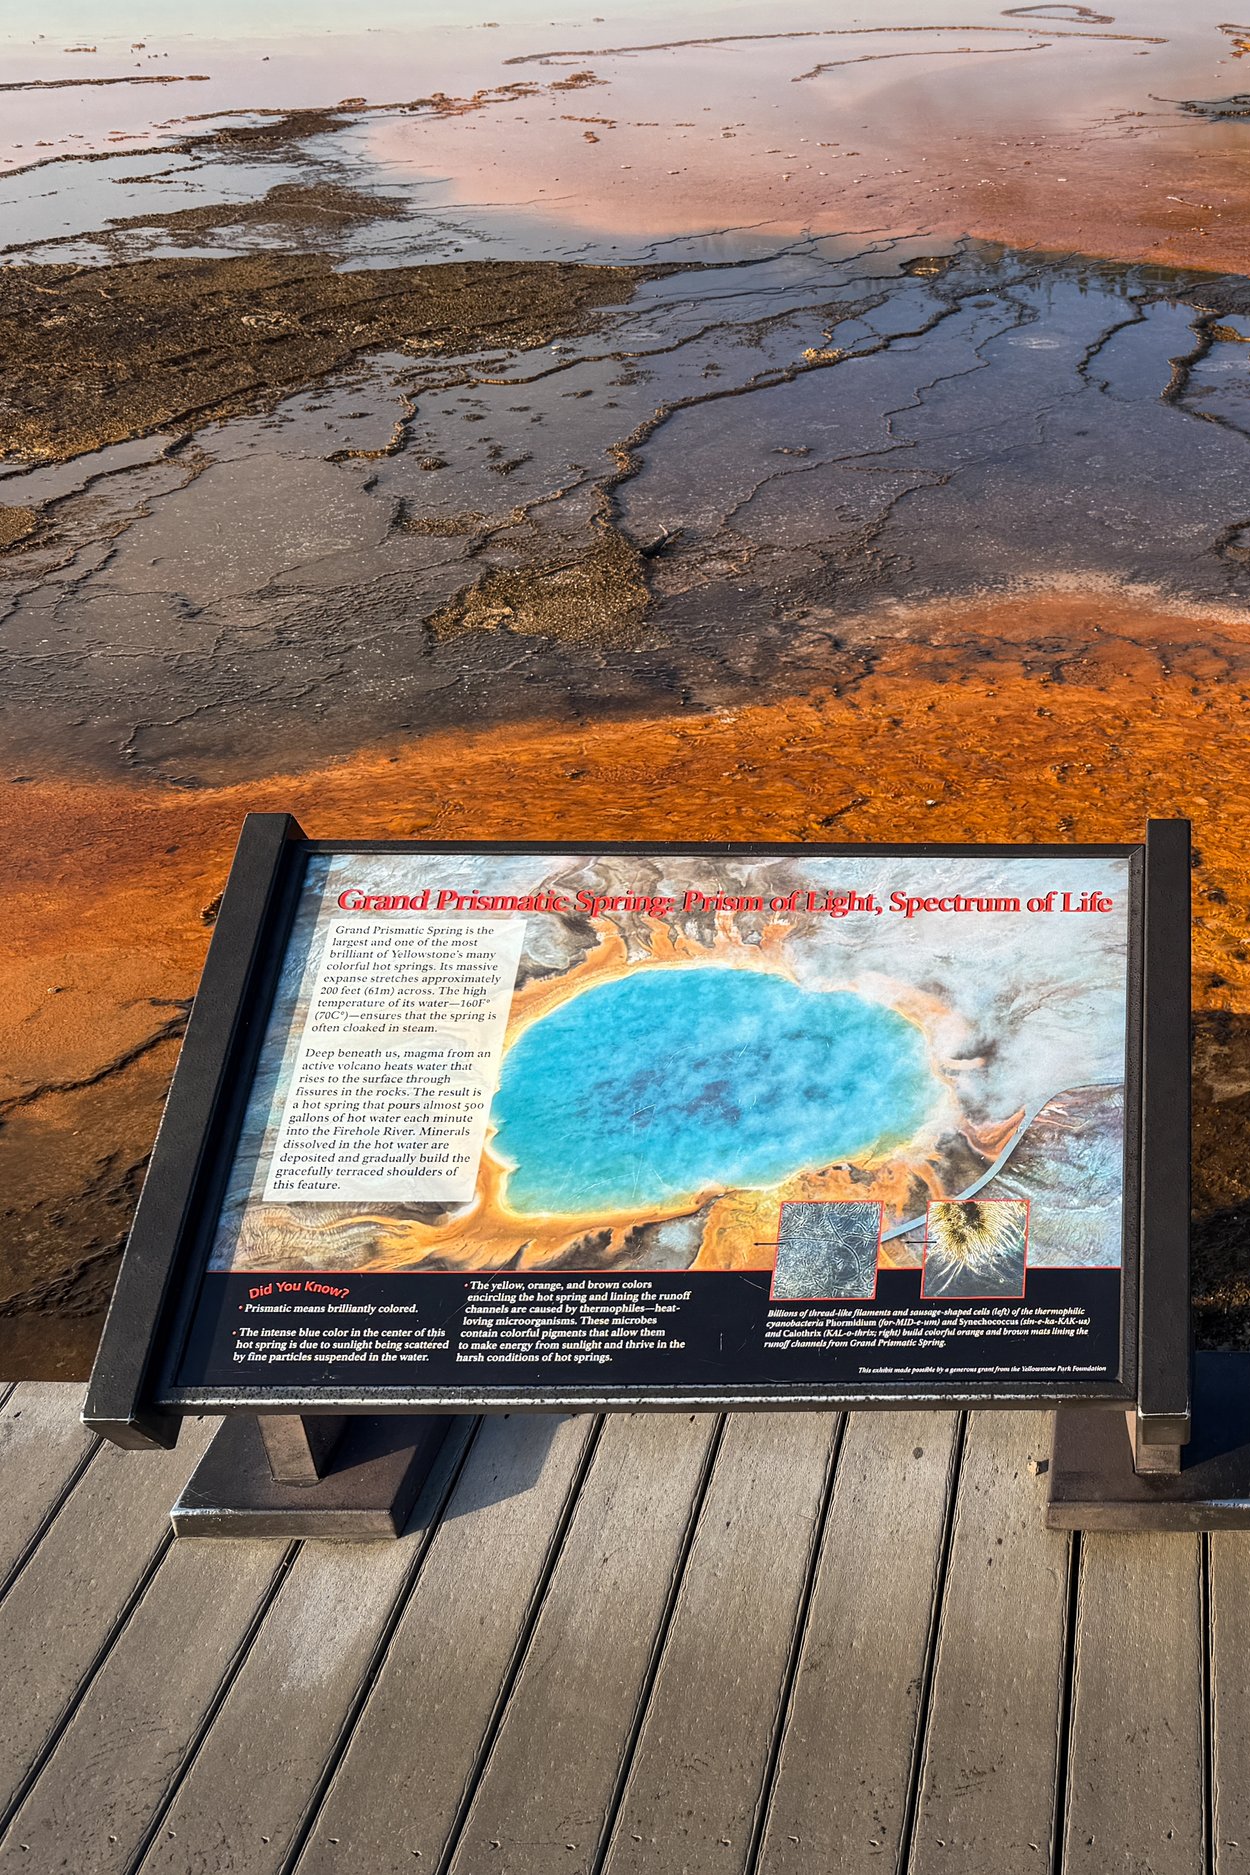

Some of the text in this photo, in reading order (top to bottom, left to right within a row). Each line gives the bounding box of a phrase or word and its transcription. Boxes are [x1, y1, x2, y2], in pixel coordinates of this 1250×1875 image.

[339, 889, 1113, 919] Grand Prismatic Spring: Prism of Light, Spectrum of Life
[335, 925, 494, 937] Grand Prismatic Spring is the
[332, 937, 368, 949] largest
[370, 937, 392, 947] and
[417, 937, 430, 947] of
[431, 938, 449, 947] the
[451, 939, 478, 947] most
[329, 949, 374, 959] brilliant
[376, 949, 390, 959] of
[466, 952, 497, 961] many
[326, 961, 498, 973] colorful hot springs. Its massive
[305, 1048, 335, 1060] Deep
[337, 1048, 382, 1058] beneath
[403, 1051, 444, 1060] magma
[447, 1048, 475, 1058] from
[273, 1179, 340, 1190] this feature.
[248, 1280, 350, 1300] Did You Know?
[470, 1279, 652, 1292] The yellow, orange, and brown colors
[244, 1303, 418, 1316] Prismatic means brilliantly colored.
[239, 1327, 446, 1338] The intense blue color in the center of this
[235, 1339, 450, 1352] hot spring is due to sunlight being scattered
[763, 1338, 946, 1350] runoff channels from Grand Prismatic Spring.
[455, 1352, 613, 1364] harsh conditions of hot springs.
[911, 1366, 936, 1374] possible
[936, 1366, 944, 1374] by
[977, 1366, 995, 1374] grant
[993, 1365, 1010, 1374] from
